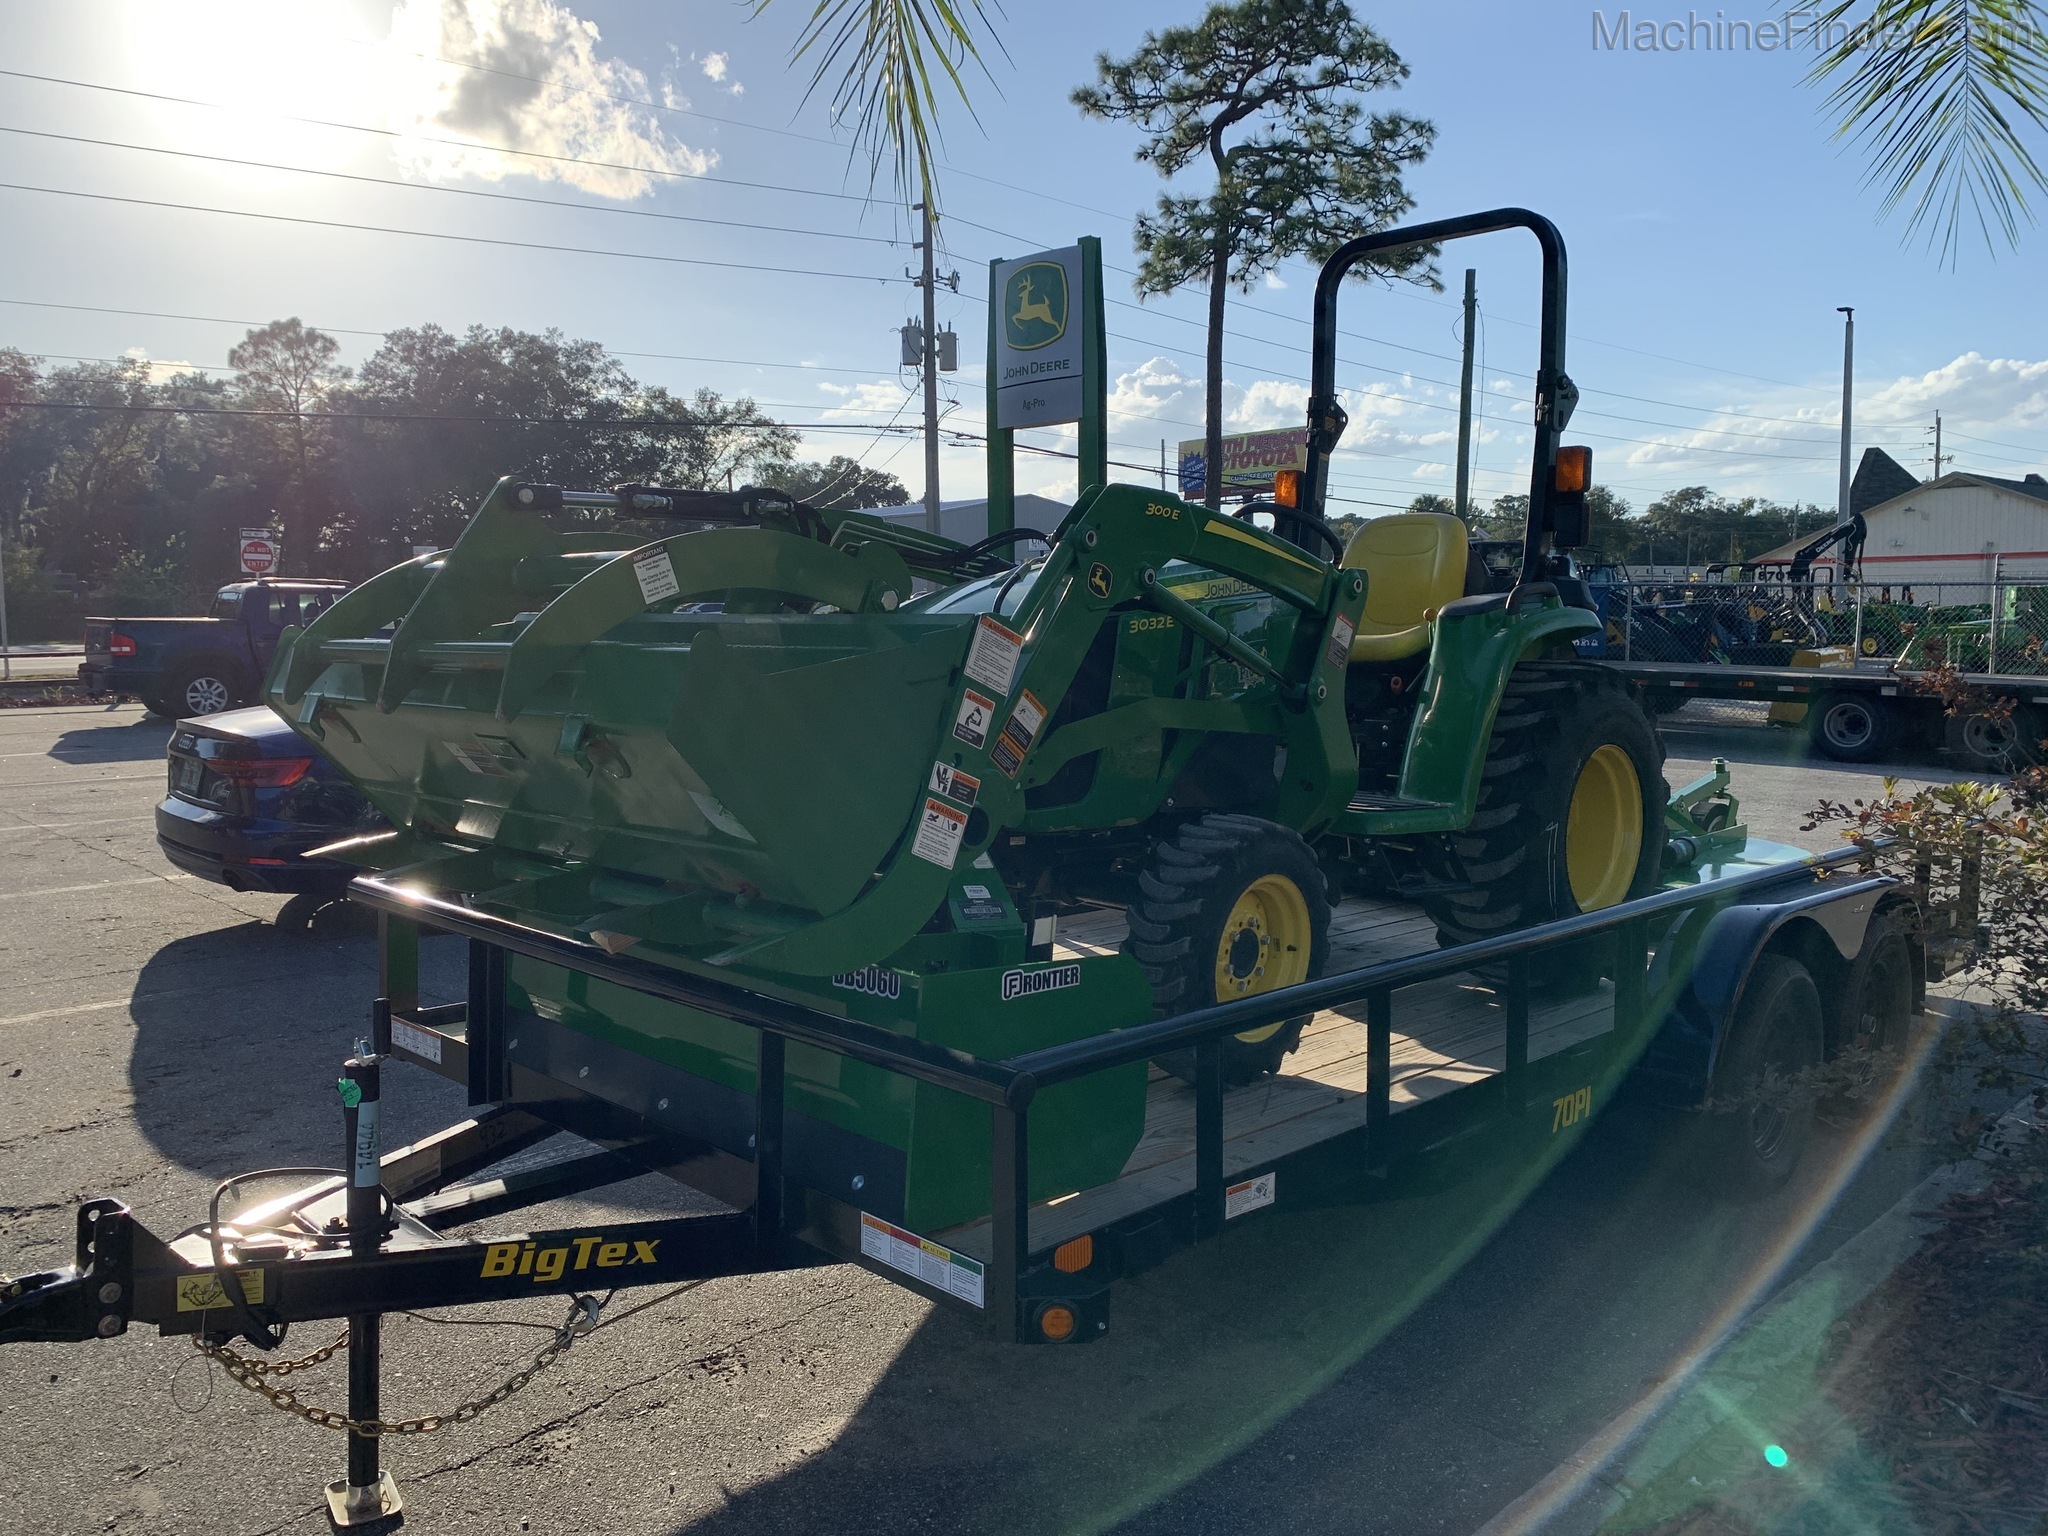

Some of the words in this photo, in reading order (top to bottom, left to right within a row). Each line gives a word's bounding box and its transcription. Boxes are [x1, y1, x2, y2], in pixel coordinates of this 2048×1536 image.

[1004, 365, 1029, 380] JOHN
[1031, 359, 1070, 374] DEERE
[1022, 398, 1046, 411] Ag-Pro
[1229, 447, 1299, 470] TOYOTA
[632, 546, 665, 562] IMPORTANT
[1204, 583, 1232, 598] JOHN
[935, 803, 963, 822] WARNING
[1002, 964, 1080, 1000] FRONTIER
[1552, 1085, 1592, 1134] 70PI
[926, 1245, 949, 1259] CAUTION
